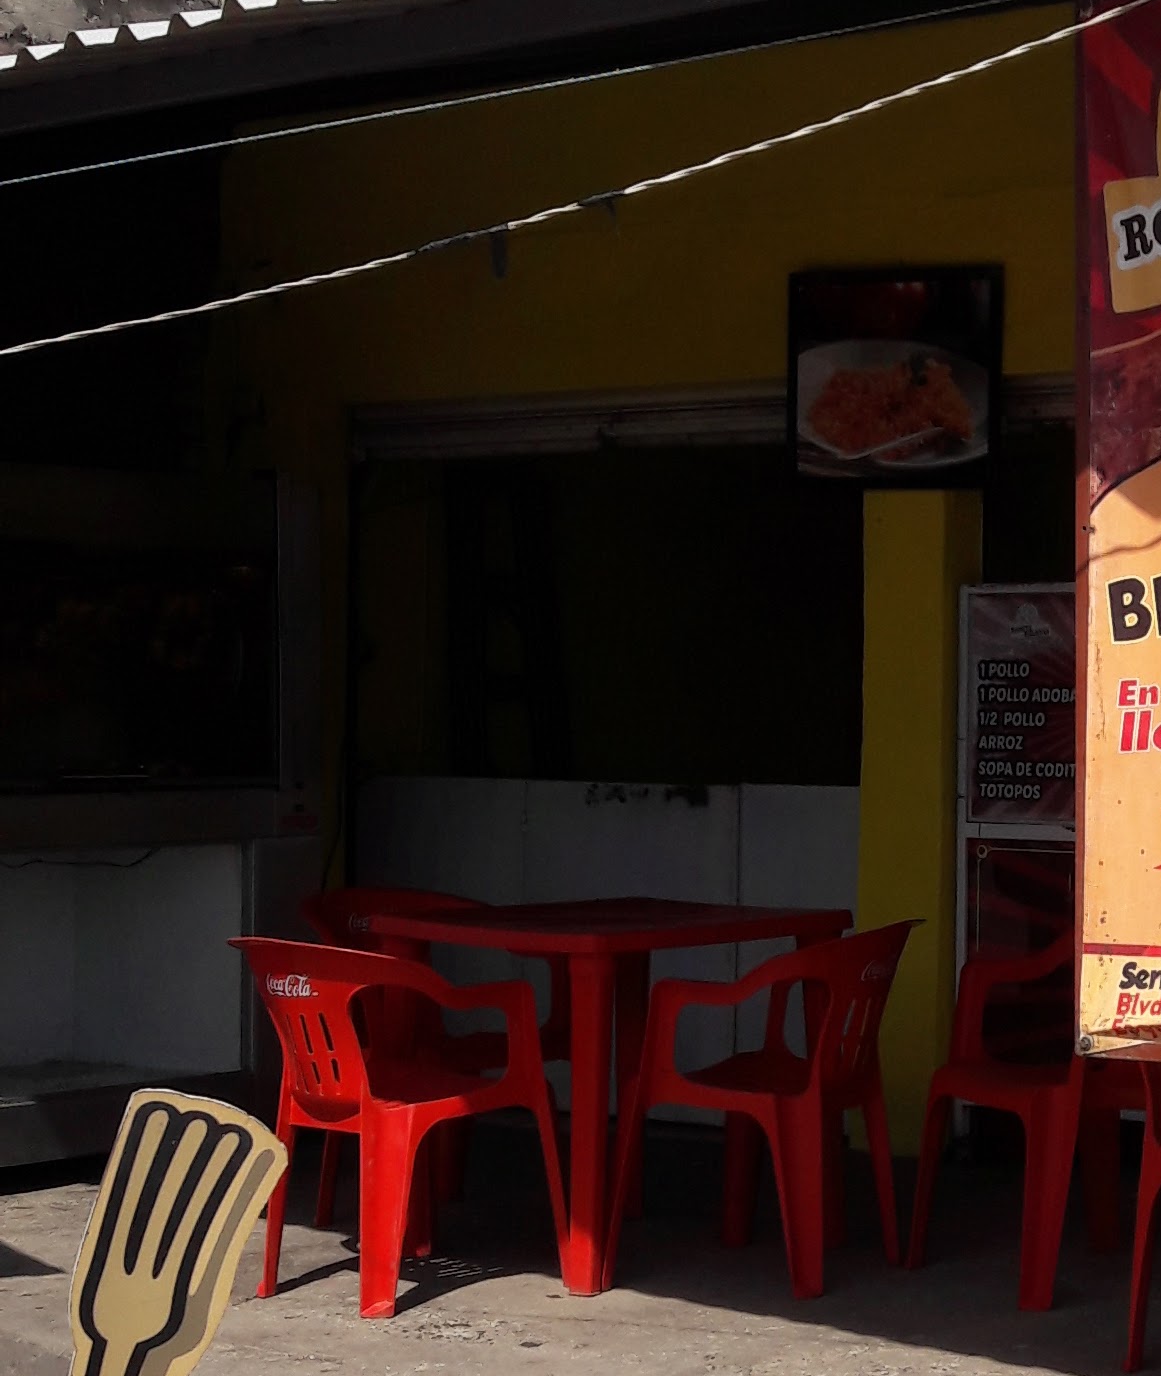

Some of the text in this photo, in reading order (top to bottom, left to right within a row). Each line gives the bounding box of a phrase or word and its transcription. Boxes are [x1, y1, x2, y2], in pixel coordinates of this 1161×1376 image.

[988, 662, 1031, 678] POLLO
[988, 687, 1030, 703] POLLO
[1118, 679, 1161, 708] En
[979, 711, 1046, 727] 1/2 POLLO
[978, 735, 1024, 751] ARROZ
[977, 761, 1014, 777] SOPA
[1015, 762, 1036, 777] DE
[979, 784, 1041, 800] TOTOPOS
